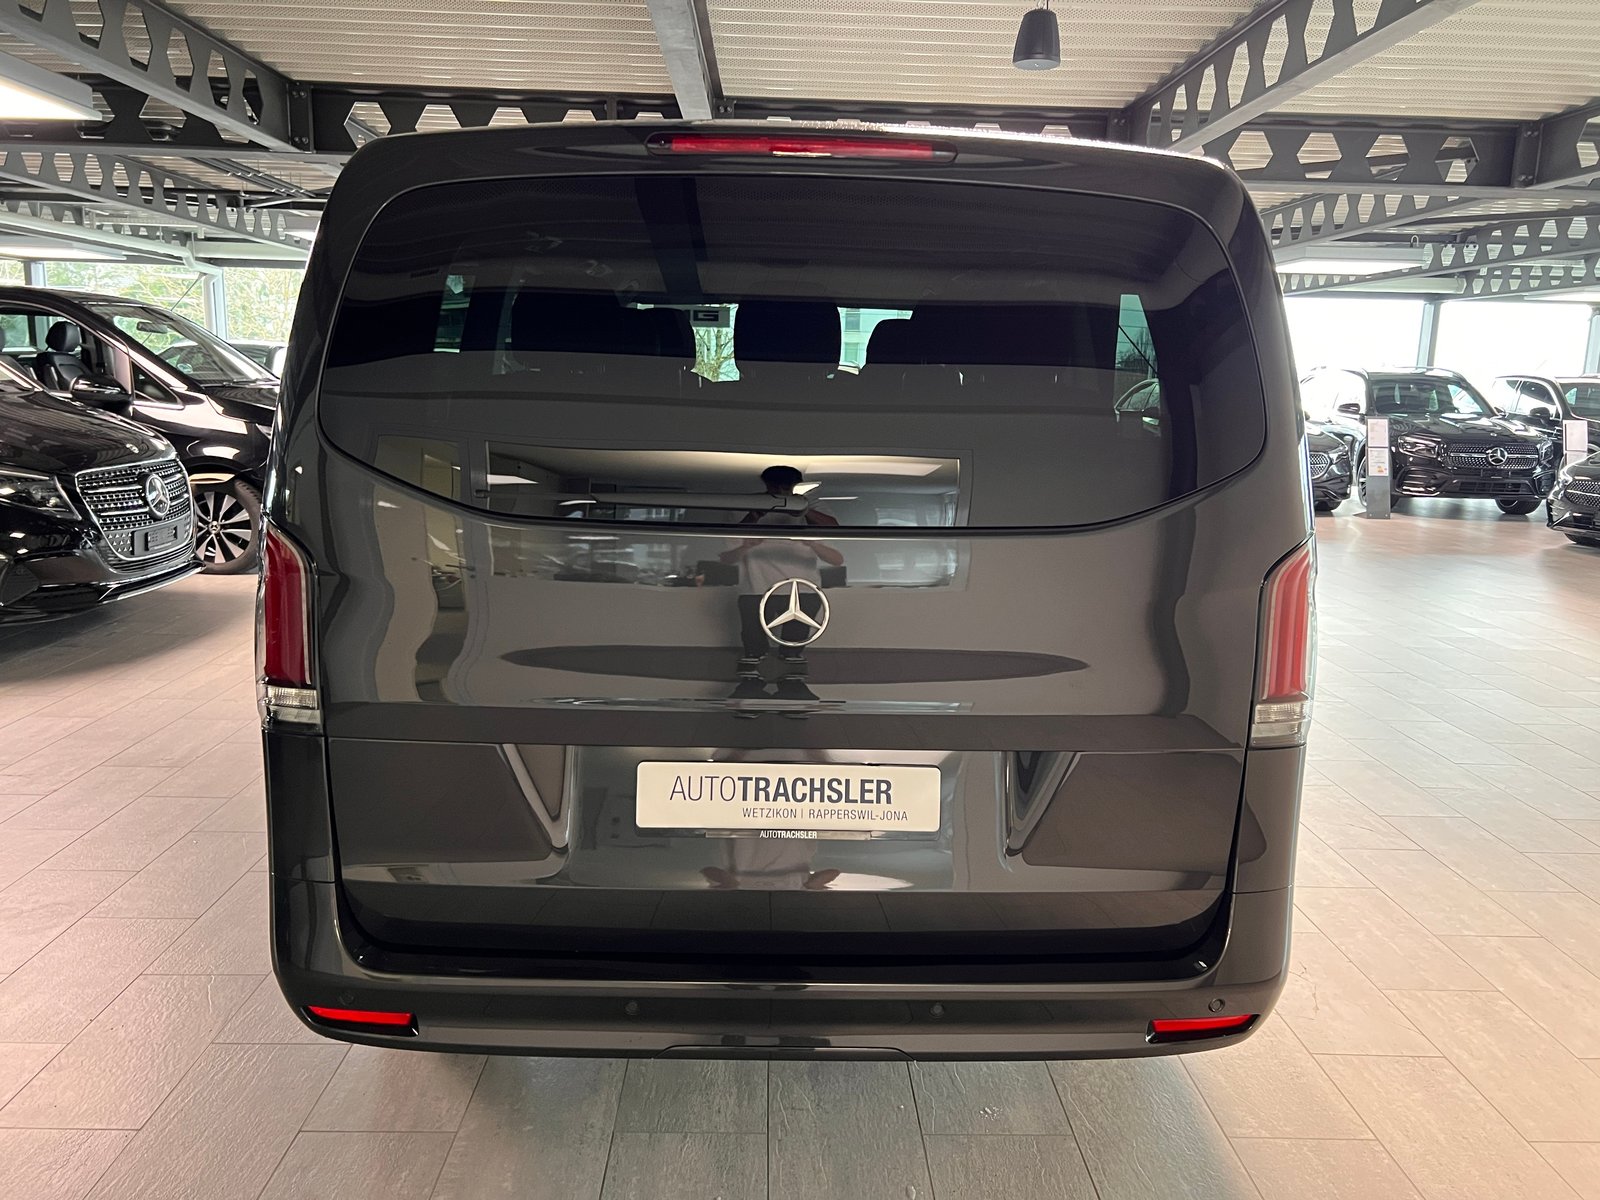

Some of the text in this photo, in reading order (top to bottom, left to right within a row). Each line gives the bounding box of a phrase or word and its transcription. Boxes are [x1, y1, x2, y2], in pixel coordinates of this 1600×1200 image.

[669, 775, 892, 804] AUTOTRACHSLER
[742, 807, 797, 818] WETZIKON
[808, 808, 908, 821] RAPPERSWIL-JONA
[759, 830, 818, 839] AUTOTRACHSLER
